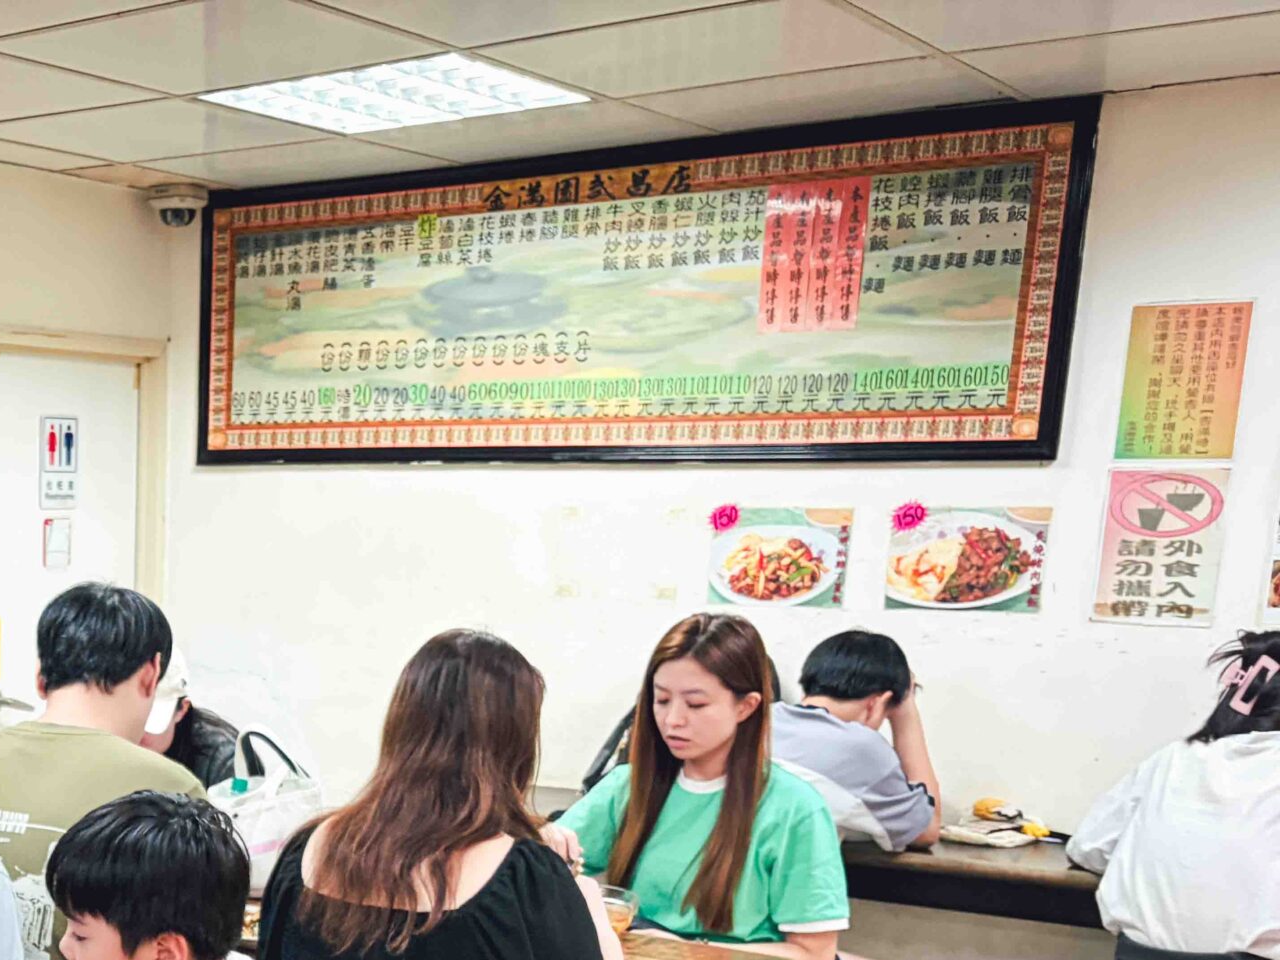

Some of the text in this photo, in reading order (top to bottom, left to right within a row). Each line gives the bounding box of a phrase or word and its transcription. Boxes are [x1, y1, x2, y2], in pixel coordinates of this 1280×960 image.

[483, 164, 693, 213] 金滿園武昌店
[712, 505, 738, 531] 150
[895, 505, 925, 527] 150
[1111, 539, 1157, 617] 請勿攜帶
[1156, 539, 1203, 619] 外食入內
